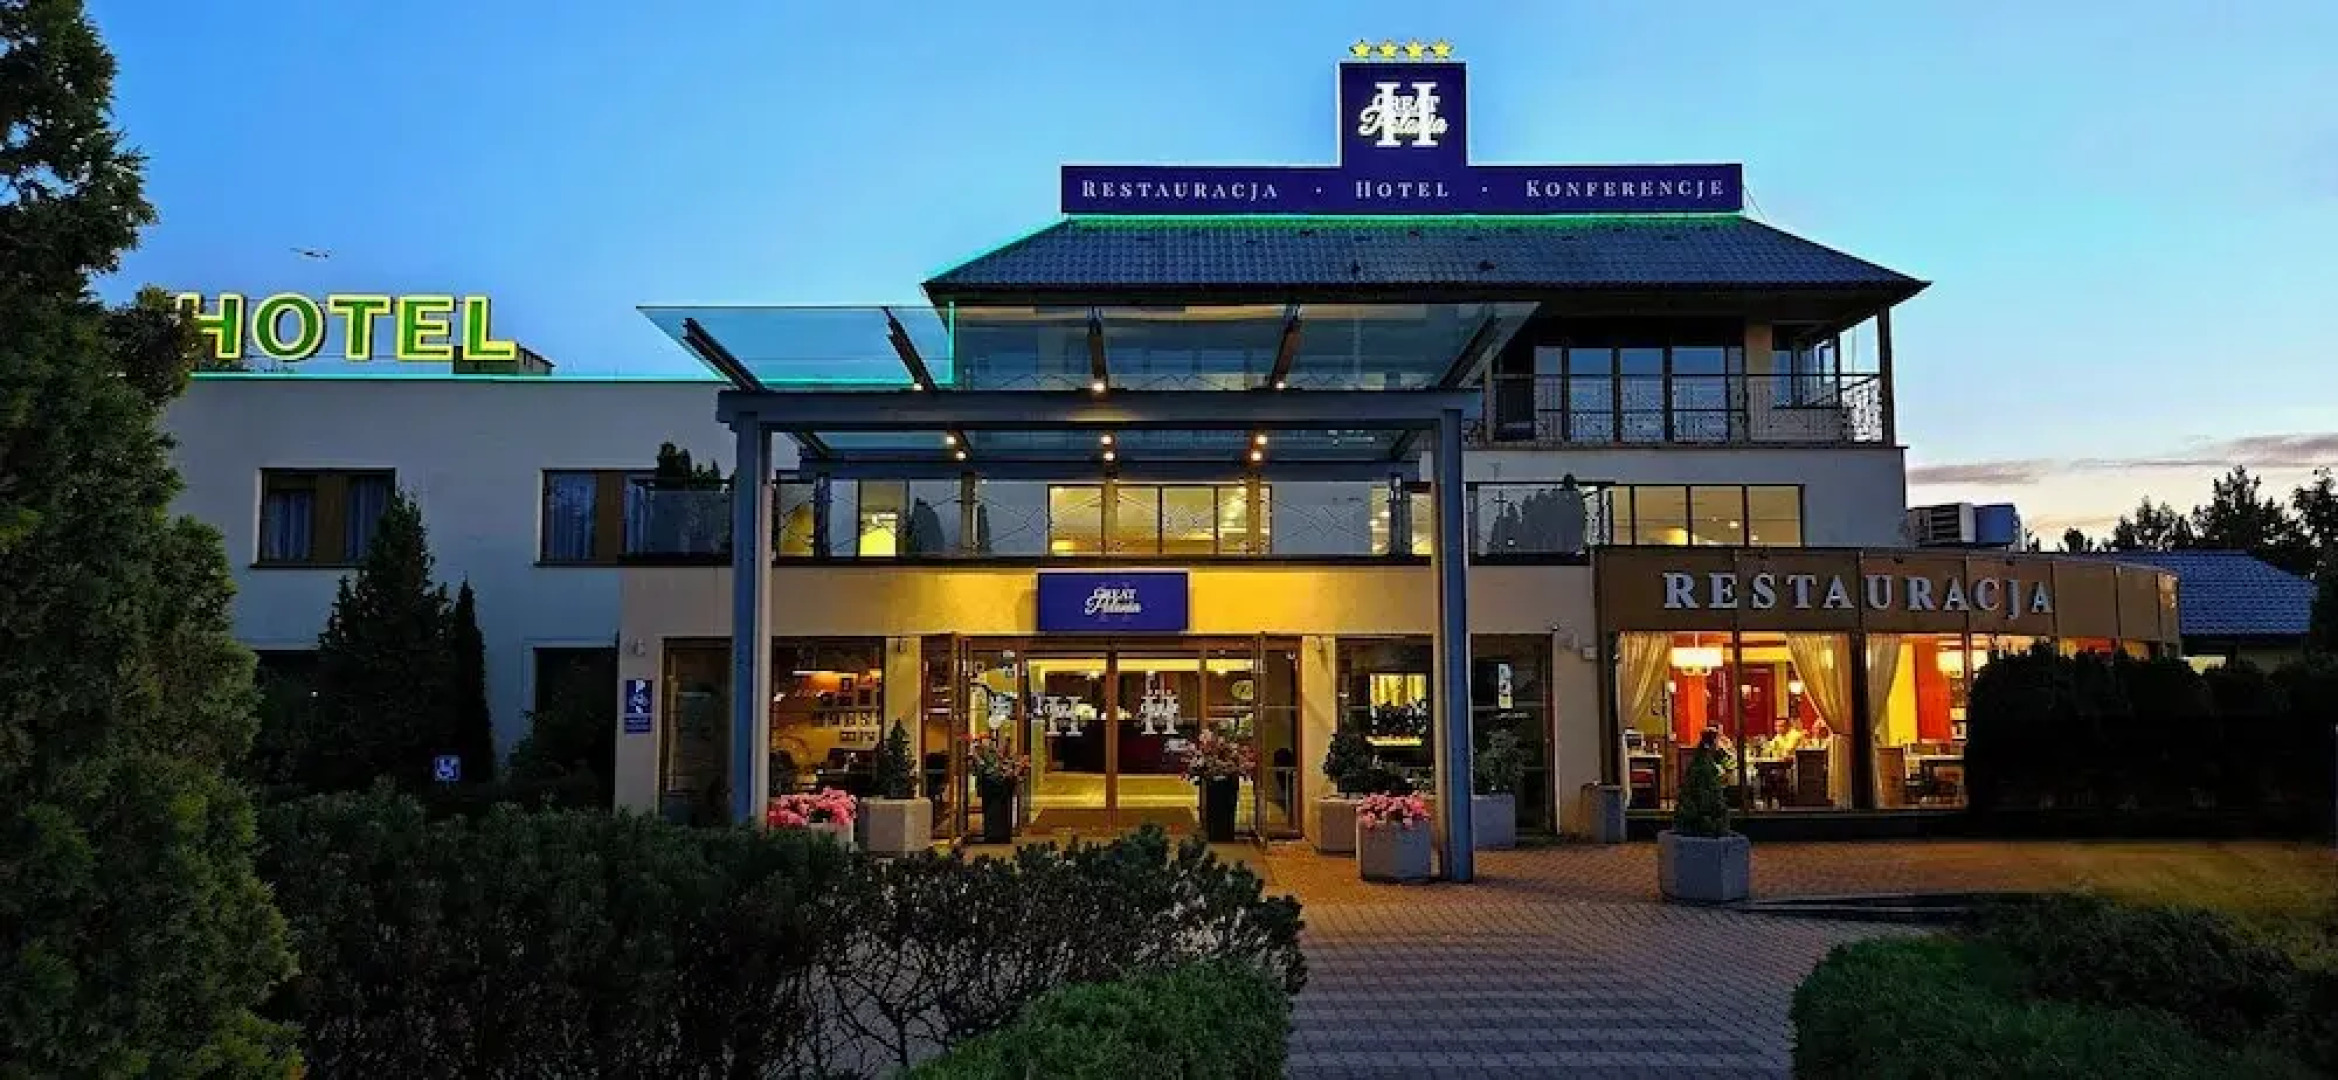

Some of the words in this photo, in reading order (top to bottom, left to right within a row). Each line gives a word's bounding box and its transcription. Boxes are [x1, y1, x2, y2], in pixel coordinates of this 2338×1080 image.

[1081, 179, 1278, 202] RESTAURACJA
[1355, 179, 1449, 198] HOTEL
[1526, 179, 1725, 199] KONFERENCJE
[175, 291, 517, 361] HOTEL
[1662, 572, 2053, 620] RESTAURACJA
